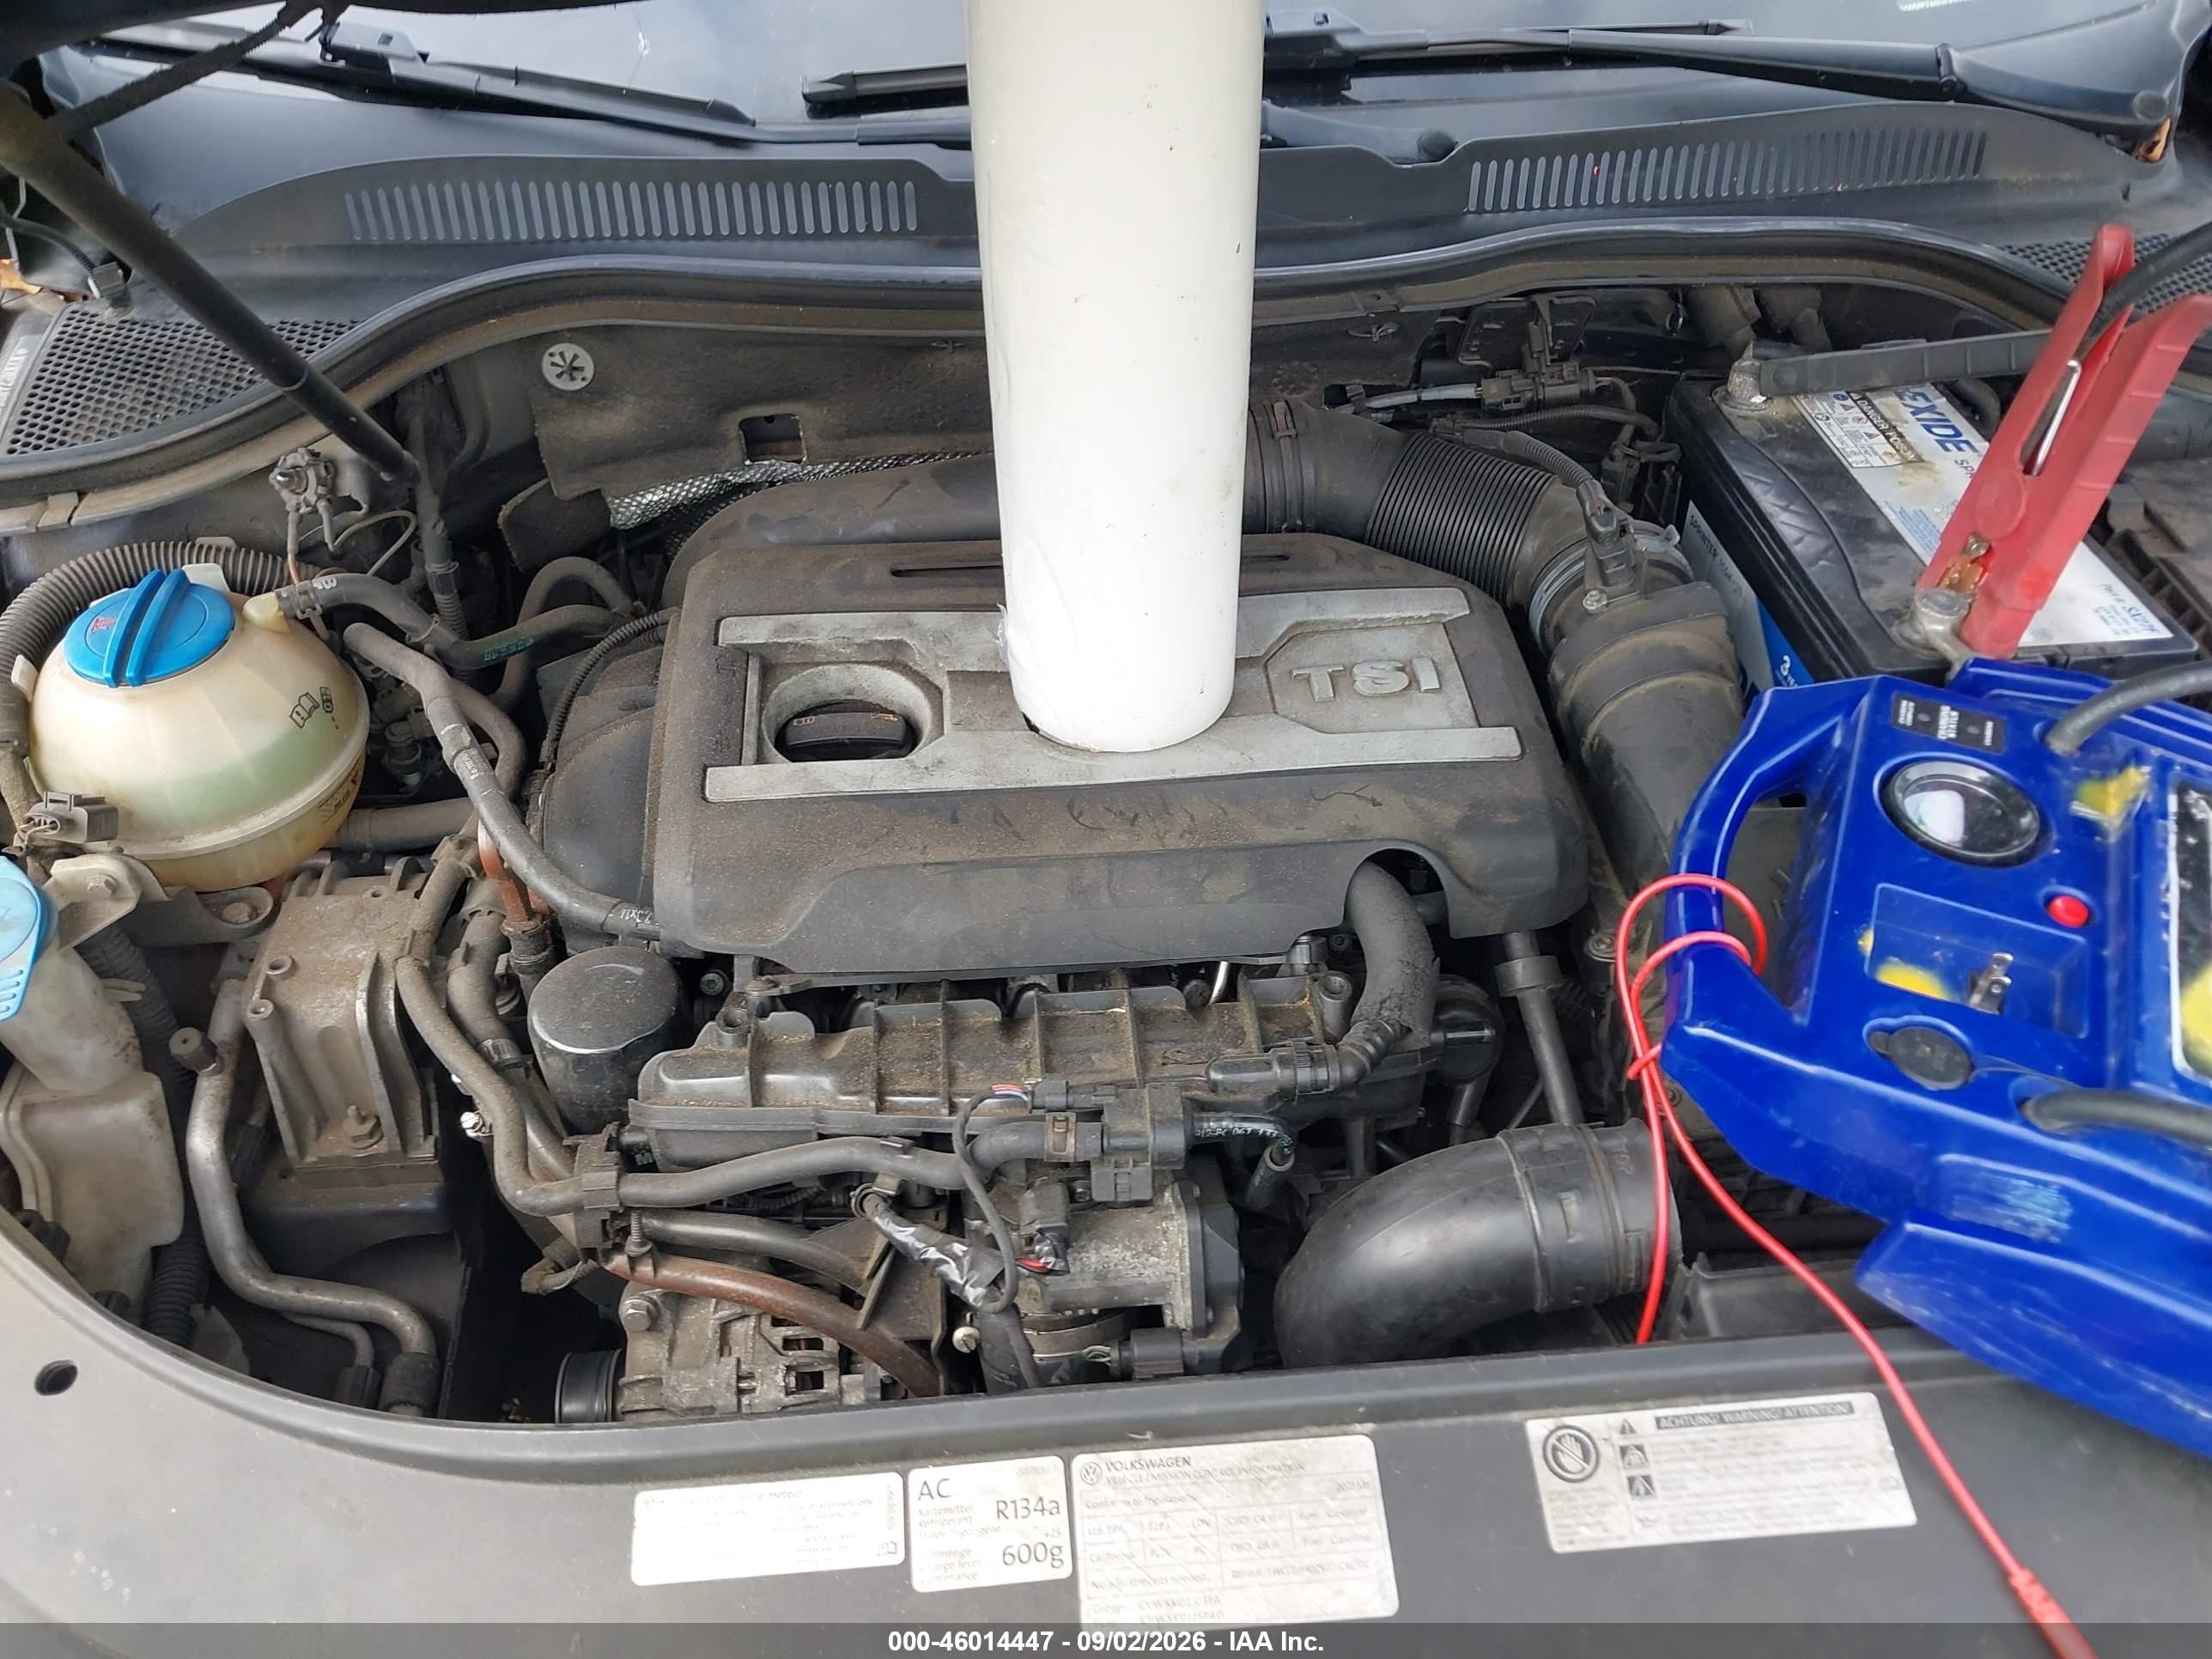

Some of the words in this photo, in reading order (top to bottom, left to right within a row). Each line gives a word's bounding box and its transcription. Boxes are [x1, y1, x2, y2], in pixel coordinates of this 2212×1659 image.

[1856, 399, 1889, 429] DANGER
[1886, 431, 1917, 462] POISON
[1895, 386, 1978, 453] EXIDE
[1690, 515, 1718, 557] SPRINTER
[1291, 657, 1442, 703] TSI
[1104, 1455, 1191, 1472] VOLKSWAGEN
[918, 1478, 951, 1501] AC
[996, 1497, 1061, 1521] R134a
[1002, 1541, 1065, 1569] 600g
